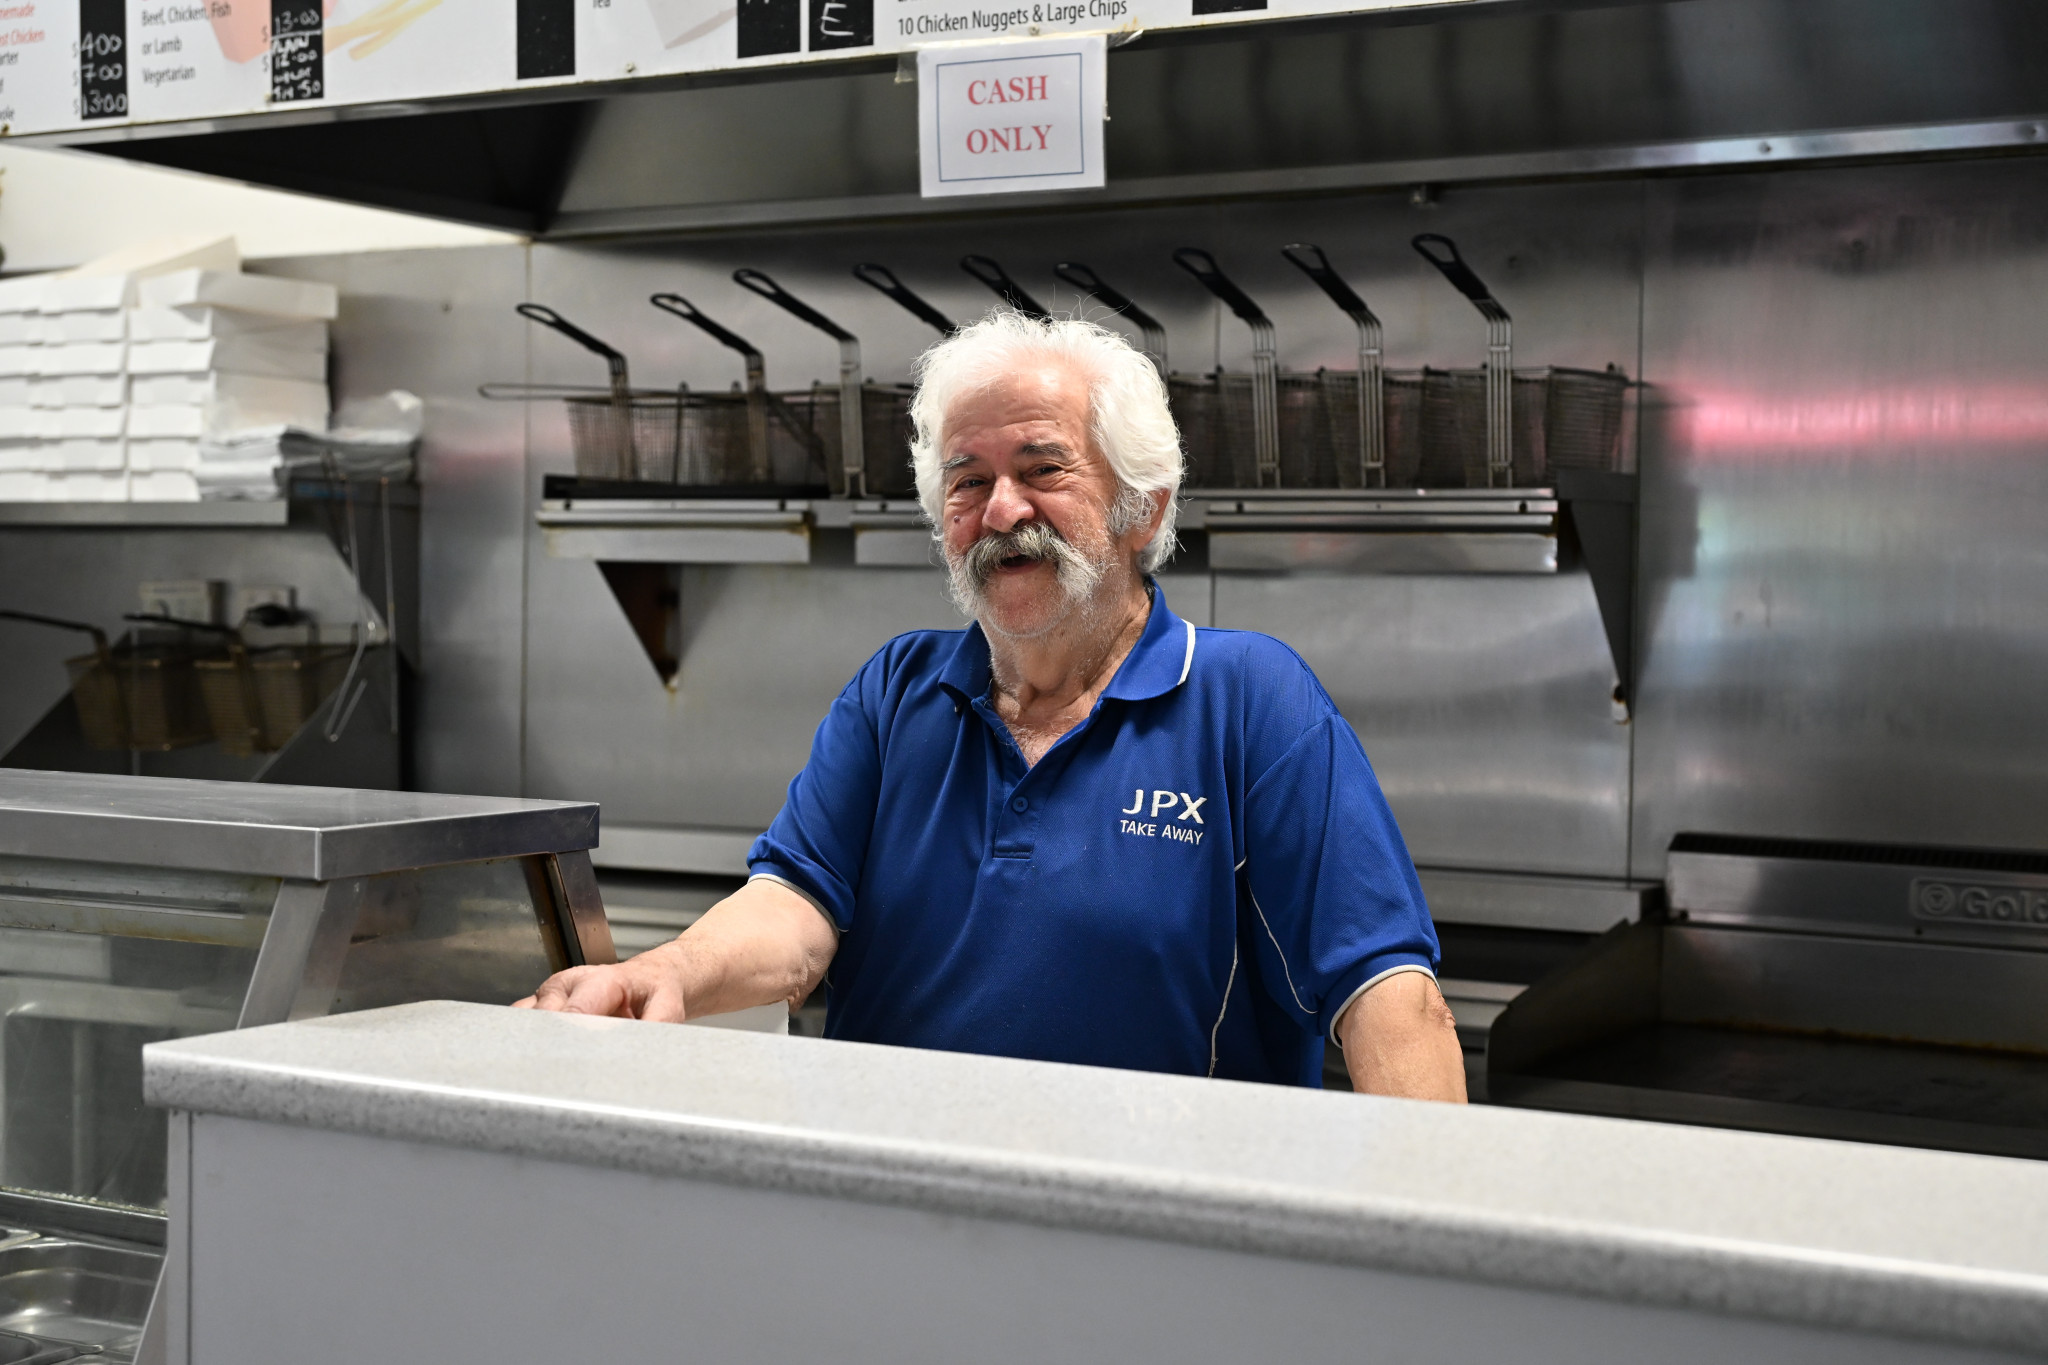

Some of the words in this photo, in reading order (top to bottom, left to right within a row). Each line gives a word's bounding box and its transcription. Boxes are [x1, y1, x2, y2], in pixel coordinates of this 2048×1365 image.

[211, 1, 232, 18] Fish
[898, 18, 914, 36] 10
[917, 13, 969, 34] Chicken
[972, 9, 1029, 32] Nuggets
[1032, 4, 1043, 23] &
[1047, 2, 1086, 24] Large
[1090, 0, 1128, 20] Chips
[154, 37, 183, 54] Lamb
[142, 67, 196, 88] Vegetarian
[967, 75, 1049, 105] CASH
[966, 124, 1053, 154] ONLY
[1122, 789, 1208, 824] JPX
[1120, 819, 1157, 837] TAKE
[1161, 824, 1204, 845] AWAY
